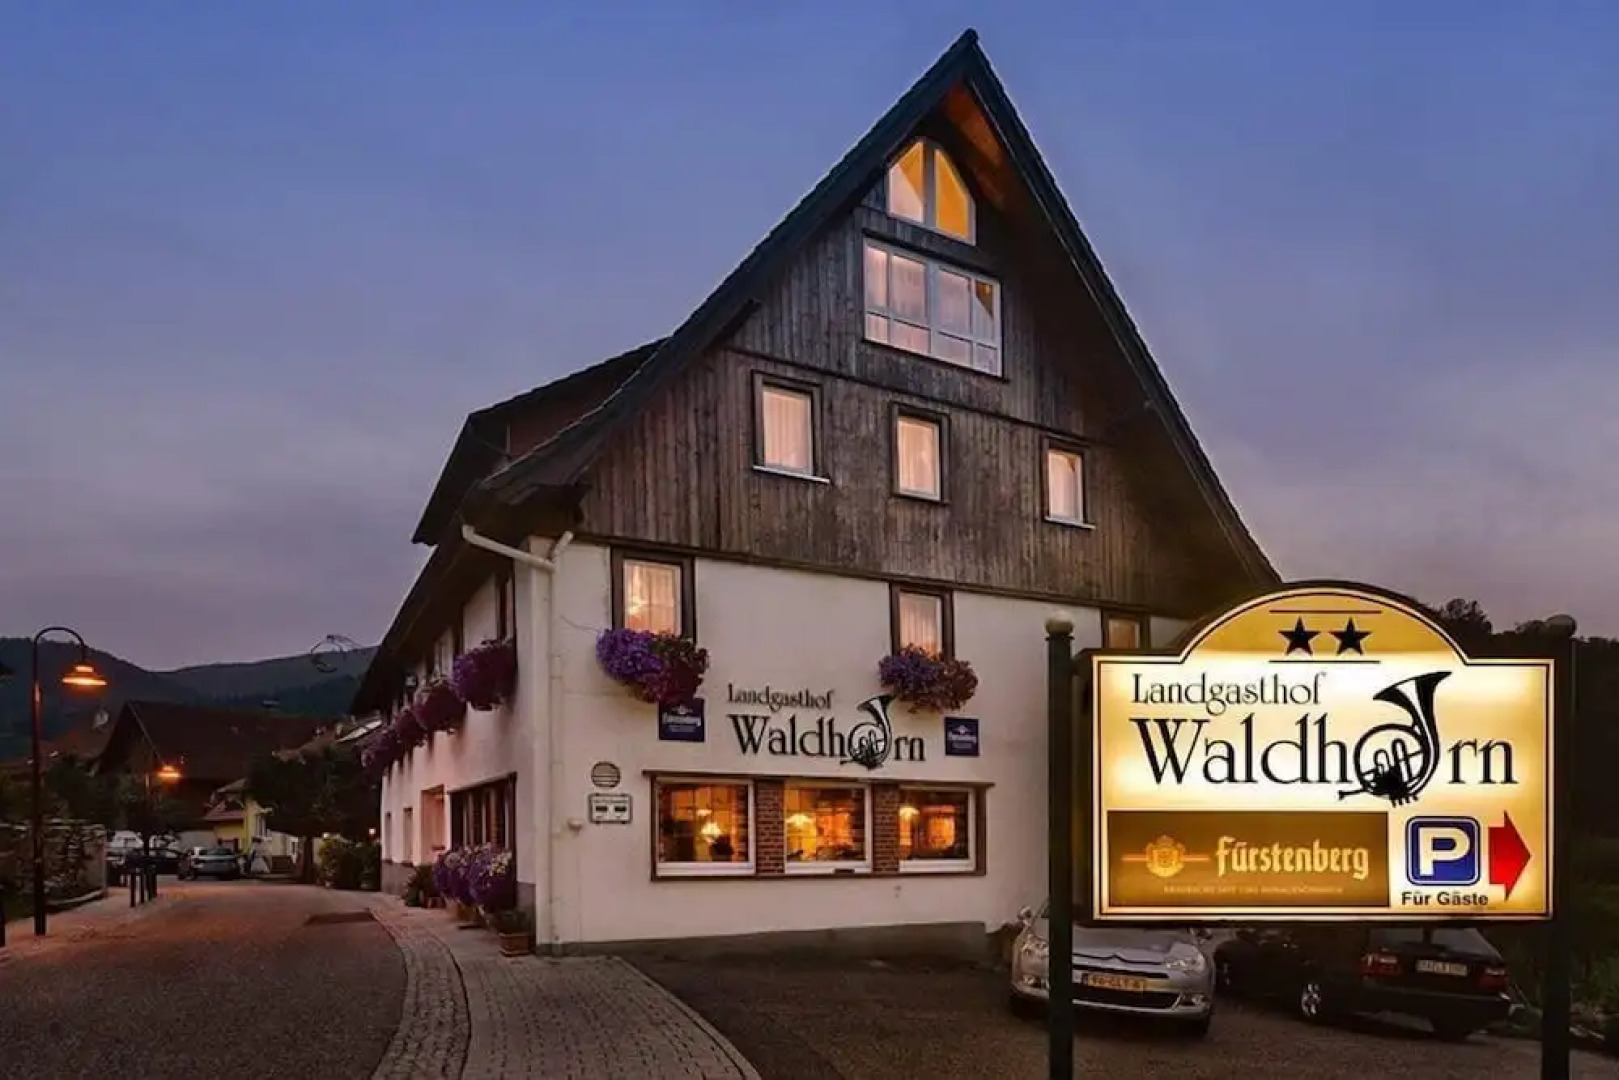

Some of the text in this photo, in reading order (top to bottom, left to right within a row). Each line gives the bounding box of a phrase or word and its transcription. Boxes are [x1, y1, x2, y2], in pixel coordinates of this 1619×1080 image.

[728, 684, 833, 711] Landgasthof
[1130, 673, 1325, 715] Landgasthof
[1217, 835, 1369, 880] Fürstenberg
[1418, 827, 1471, 876] P
[1401, 890, 1489, 906] Für Gäste
